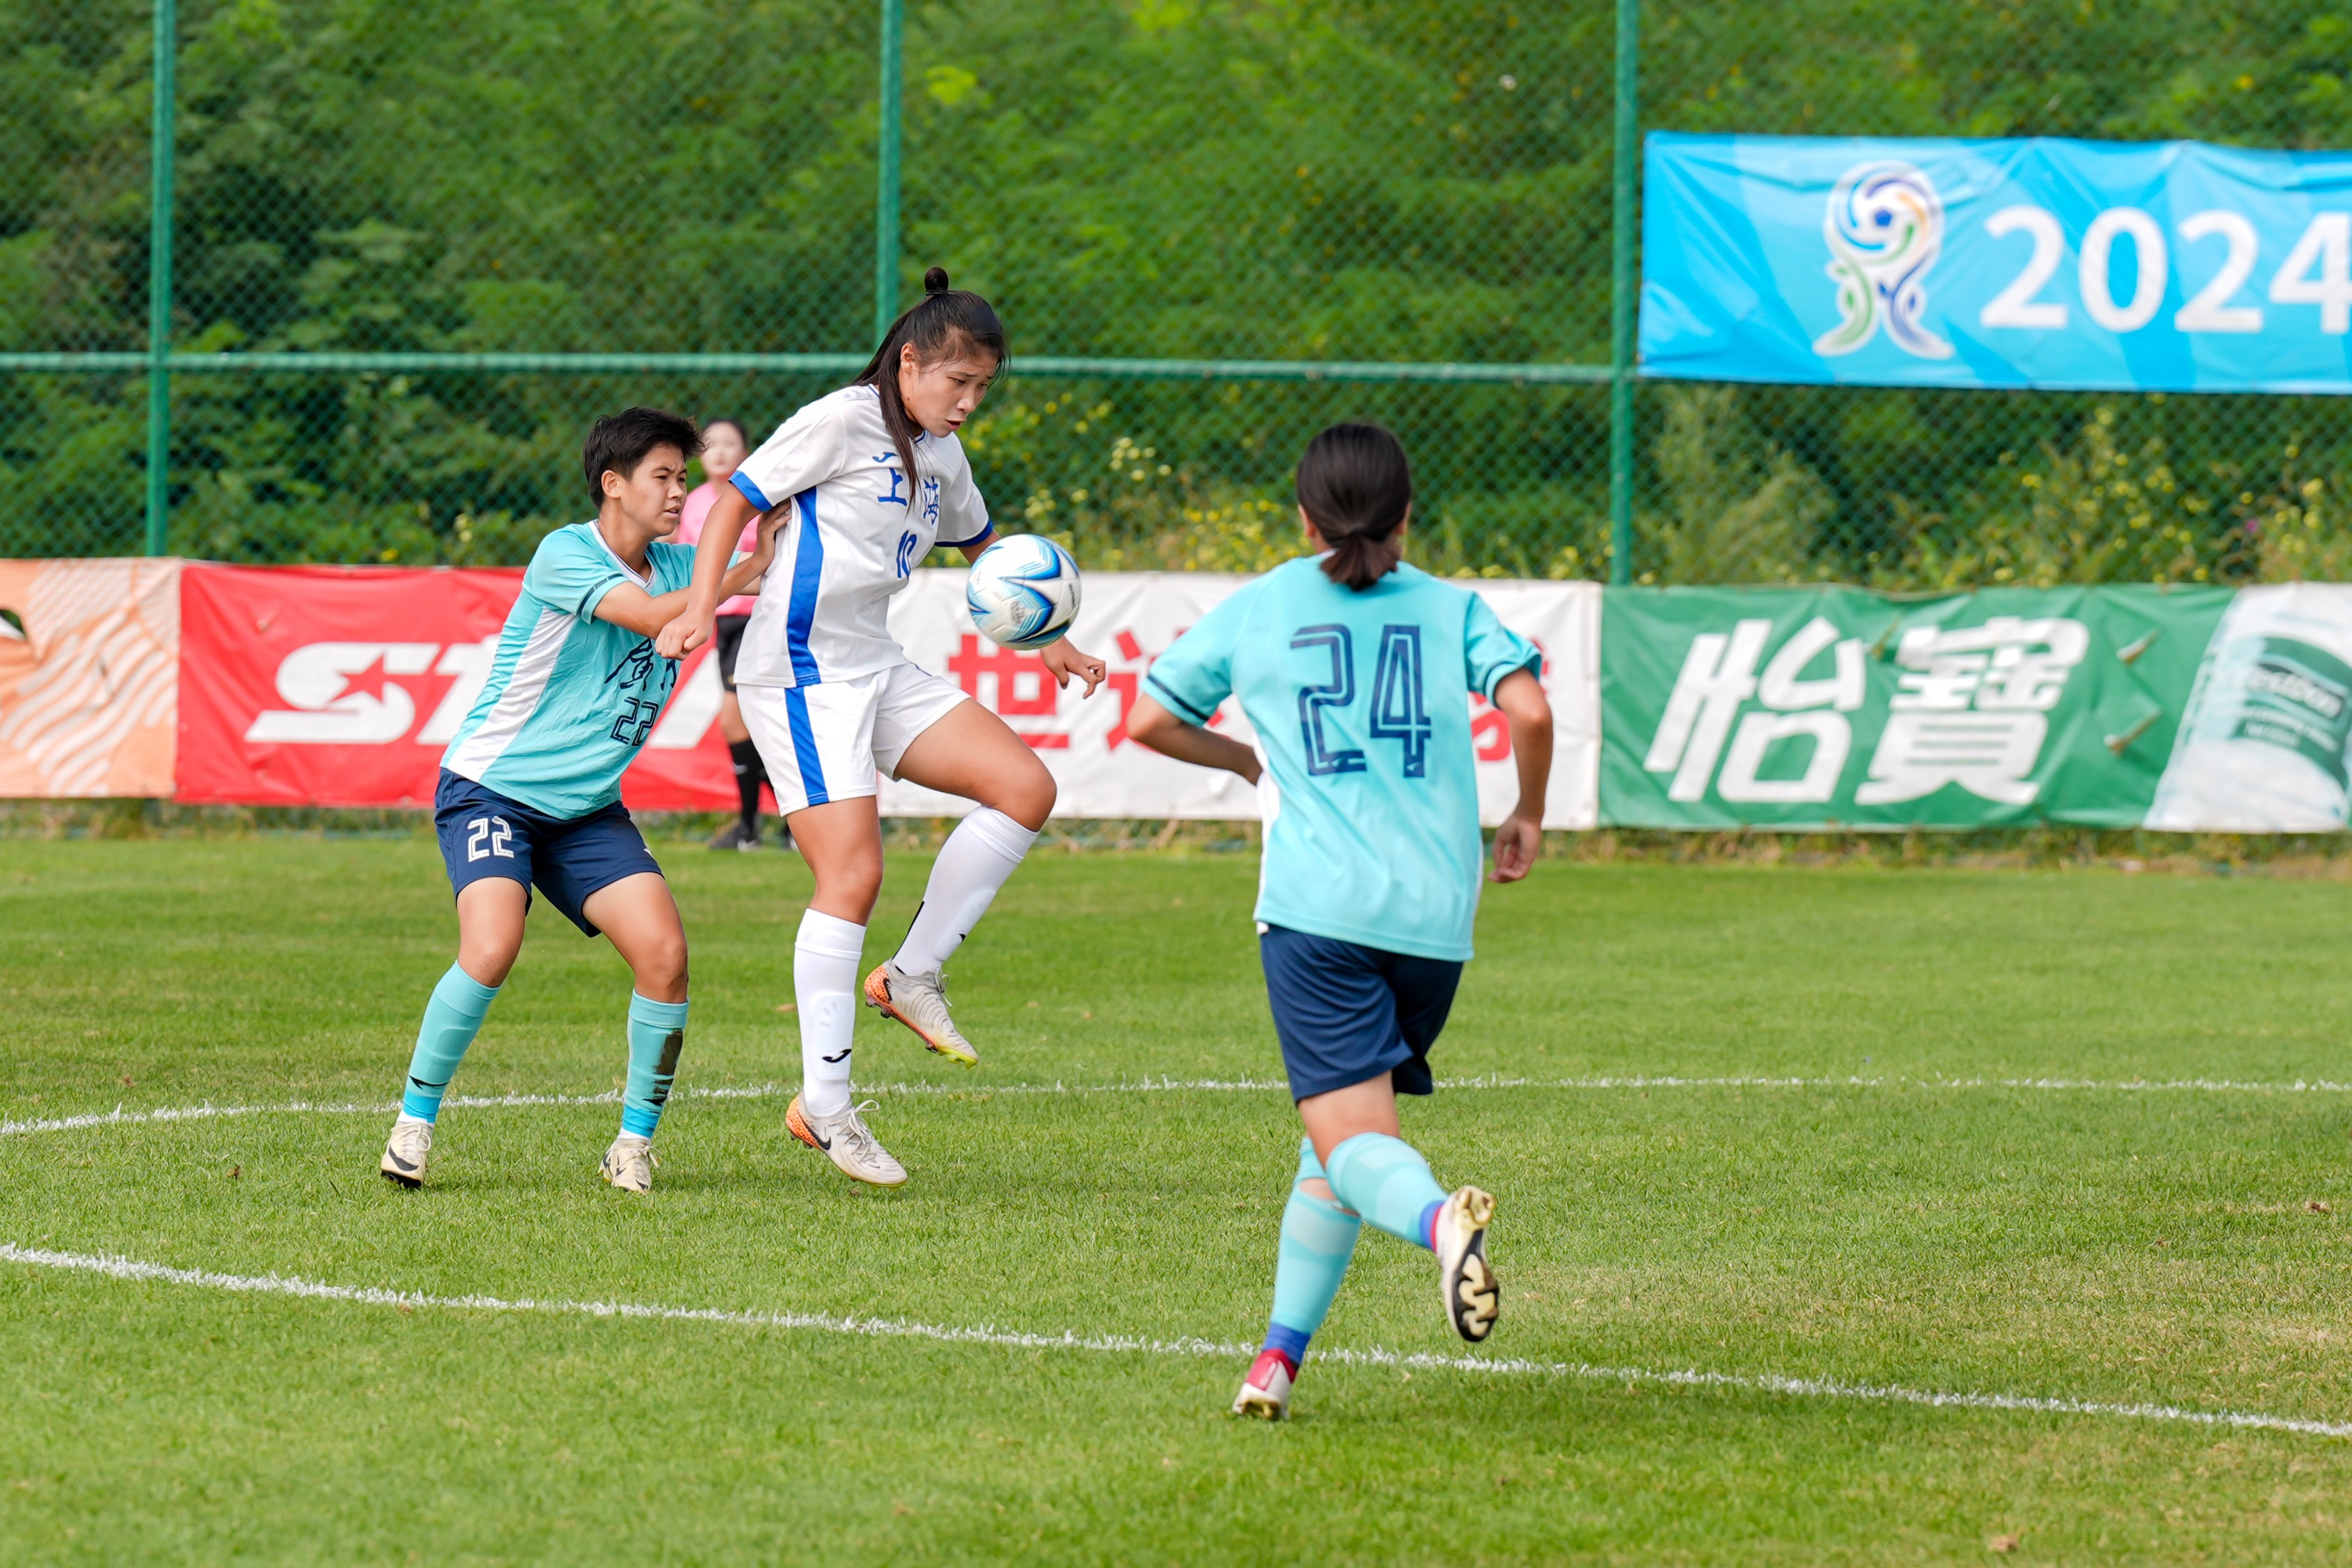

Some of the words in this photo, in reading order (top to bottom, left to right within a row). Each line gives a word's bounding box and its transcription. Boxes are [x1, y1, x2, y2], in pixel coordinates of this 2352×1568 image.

[1979, 204, 2352, 334] 2024
[610, 697, 659, 747] 22
[1289, 624, 1431, 779] 24
[1643, 614, 2090, 806] 怡寶
[467, 815, 515, 863] 22
